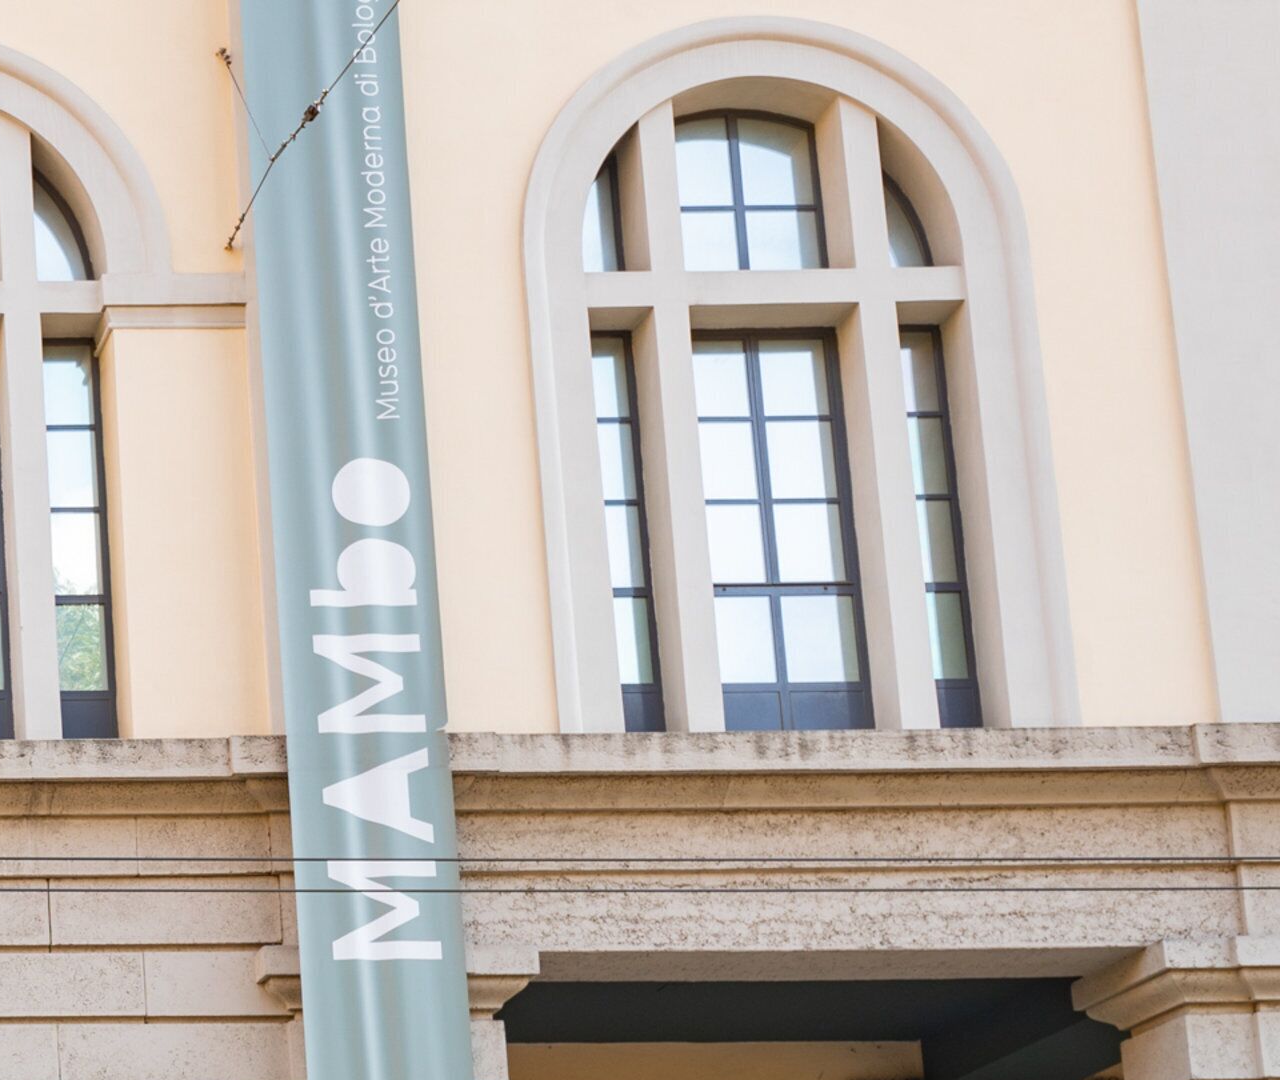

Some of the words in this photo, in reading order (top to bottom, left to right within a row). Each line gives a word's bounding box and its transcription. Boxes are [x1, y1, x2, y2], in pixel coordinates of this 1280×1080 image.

[351, 0, 378, 64] Bolo
[353, 73, 380, 97] di
[361, 105, 388, 228] Moderna
[366, 237, 395, 319] d'Arte
[375, 328, 401, 420] Museo
[310, 457, 443, 961] MAMbo
